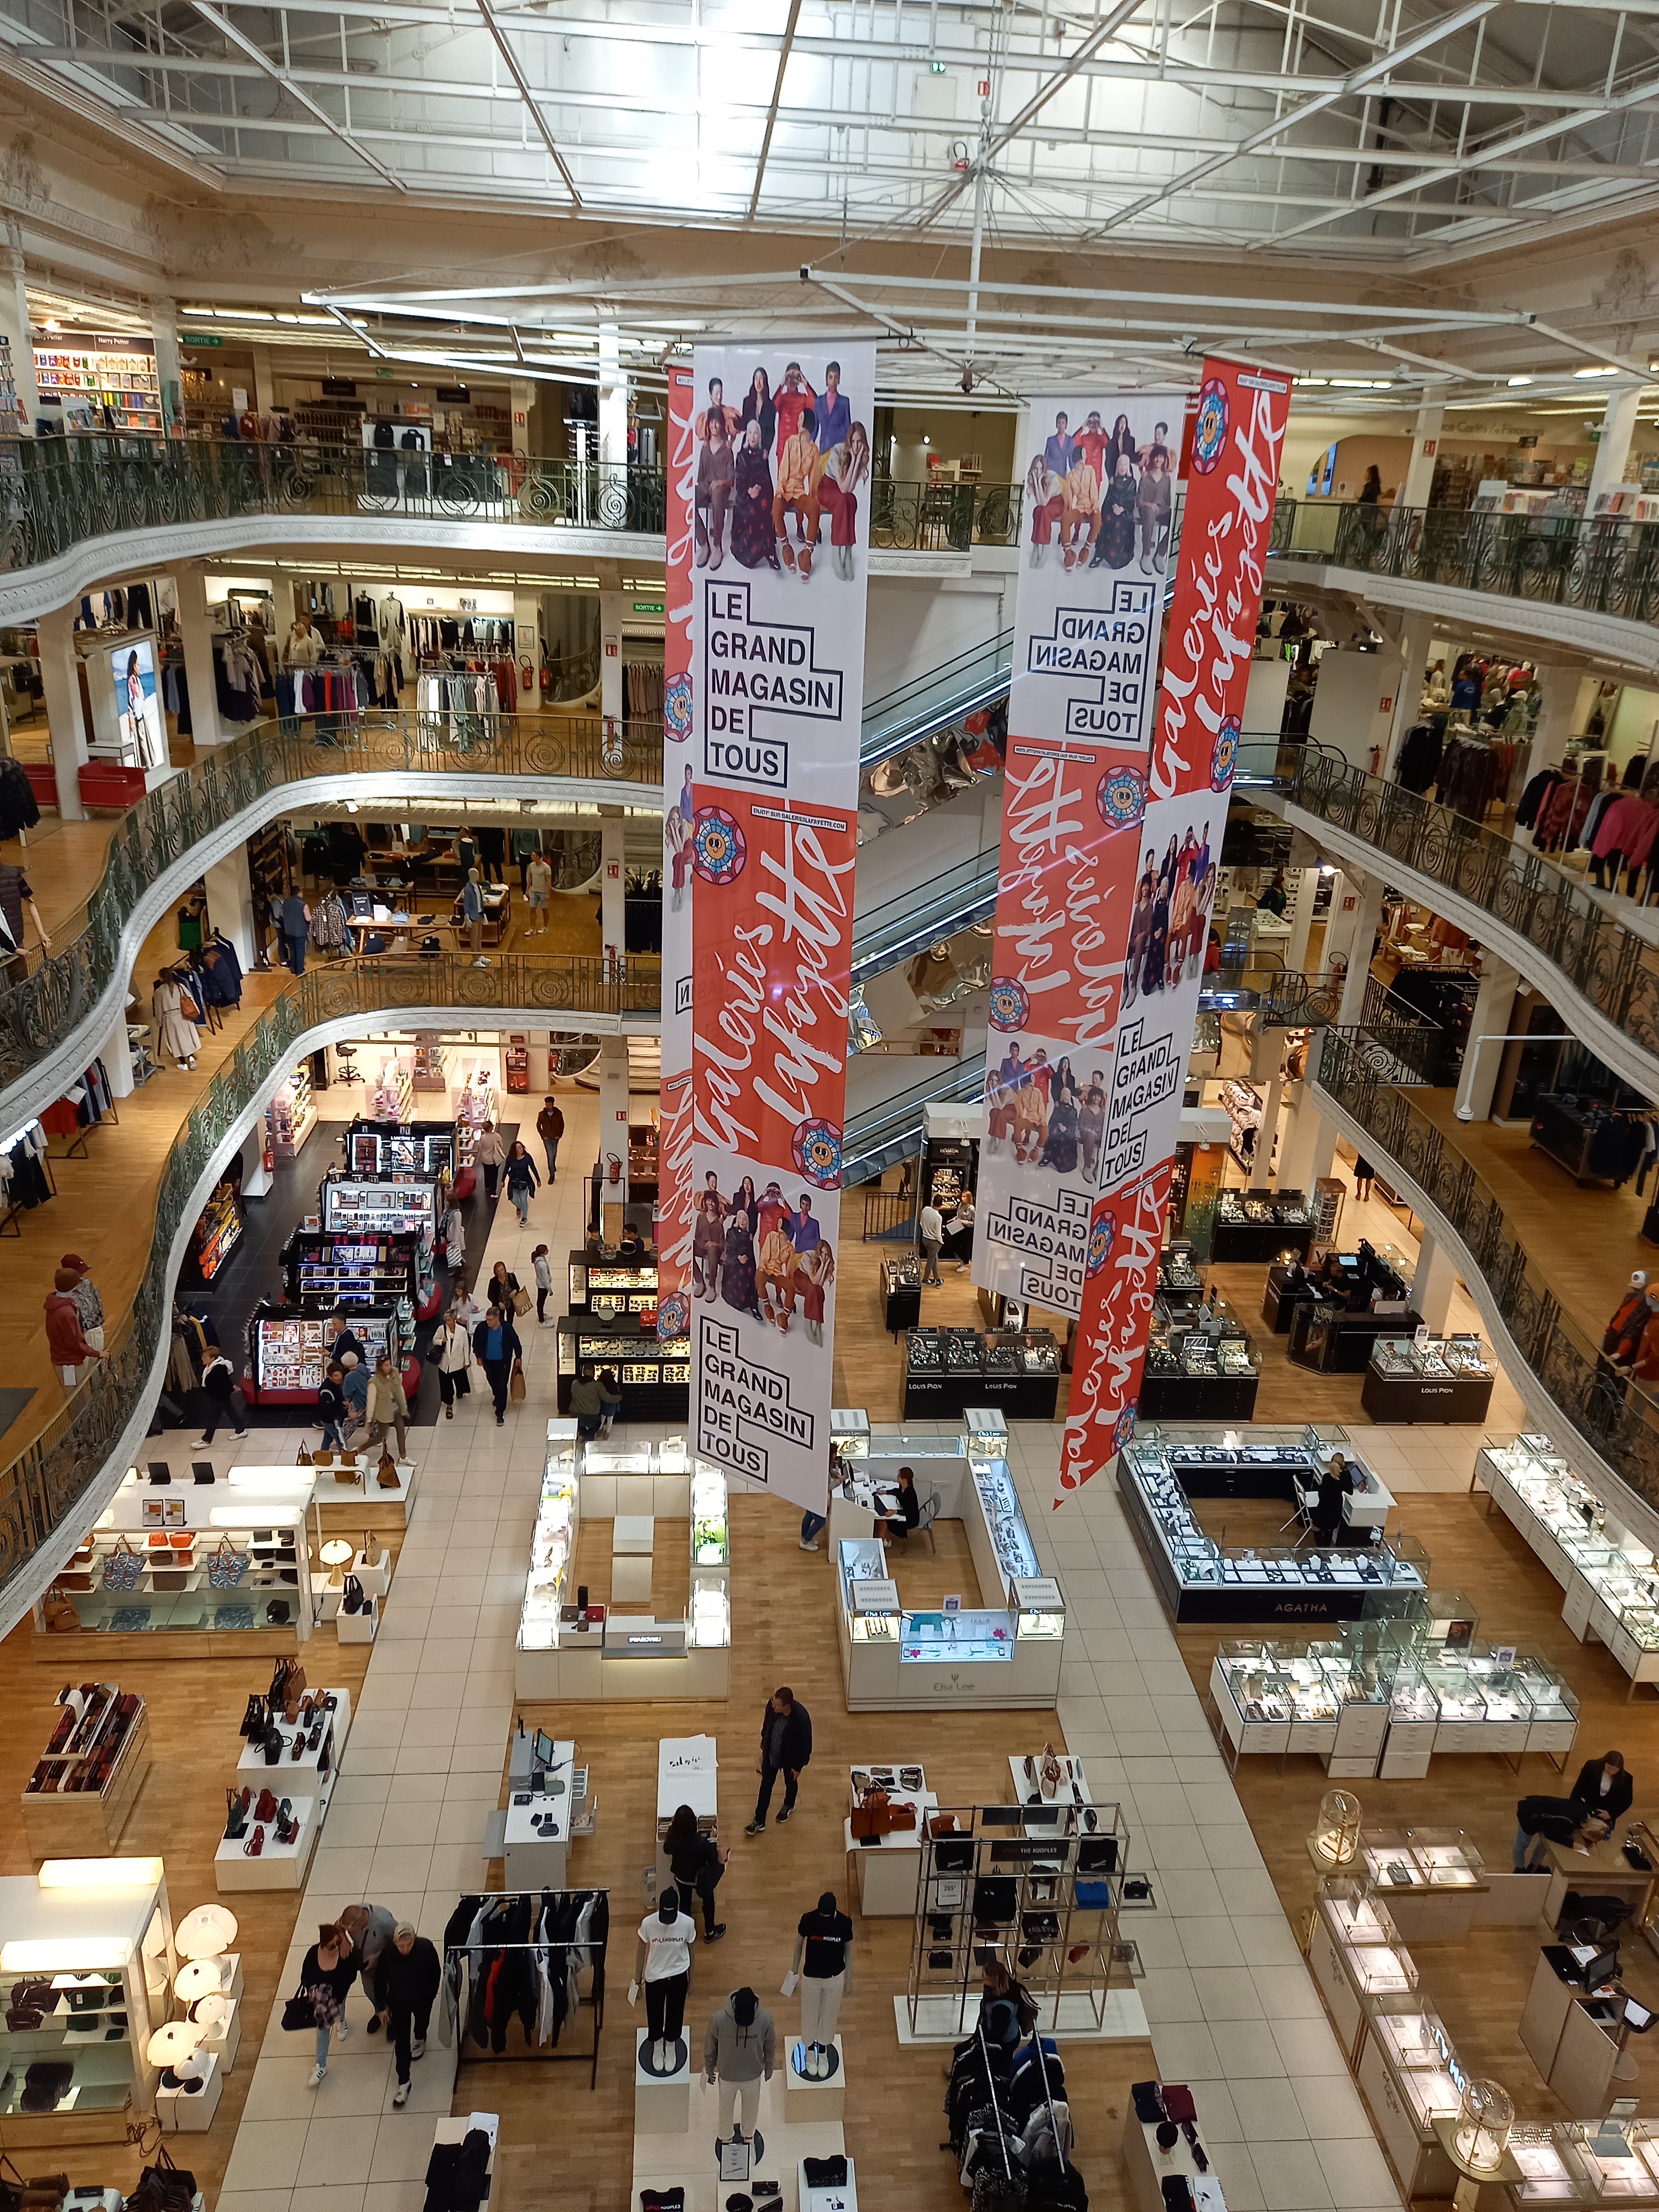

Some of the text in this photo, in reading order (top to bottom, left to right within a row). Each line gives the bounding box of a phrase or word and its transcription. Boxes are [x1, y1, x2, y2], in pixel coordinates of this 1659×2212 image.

[185, 335, 210, 345] SORTIE
[1195, 368, 1285, 734] Lafayette
[711, 592, 742, 620] LE
[711, 632, 806, 665] GRAND
[711, 669, 833, 709] MAGASIN
[711, 706, 744, 735] DE
[710, 742, 779, 777] TOUS
[781, 813, 845, 830] GALERIESLAFAYETTE.COM
[753, 800, 856, 1126] Lafayette
[1120, 1029, 1140, 1058] LE
[1117, 1046, 1166, 1088] GRAND
[1112, 1067, 1175, 1120] MAGASIN
[1108, 1121, 1129, 1151] DE
[1105, 1142, 1142, 1180] TOUS
[706, 1326, 732, 1354] LE
[705, 1354, 783, 1401] GRAND
[704, 1404, 732, 1434] DE
[705, 1379, 806, 1439] MAGASIN
[703, 1430, 760, 1472] TOUS
[1275, 1604, 1327, 1612] AGATHA
[934, 1682, 953, 1691] Elsa
